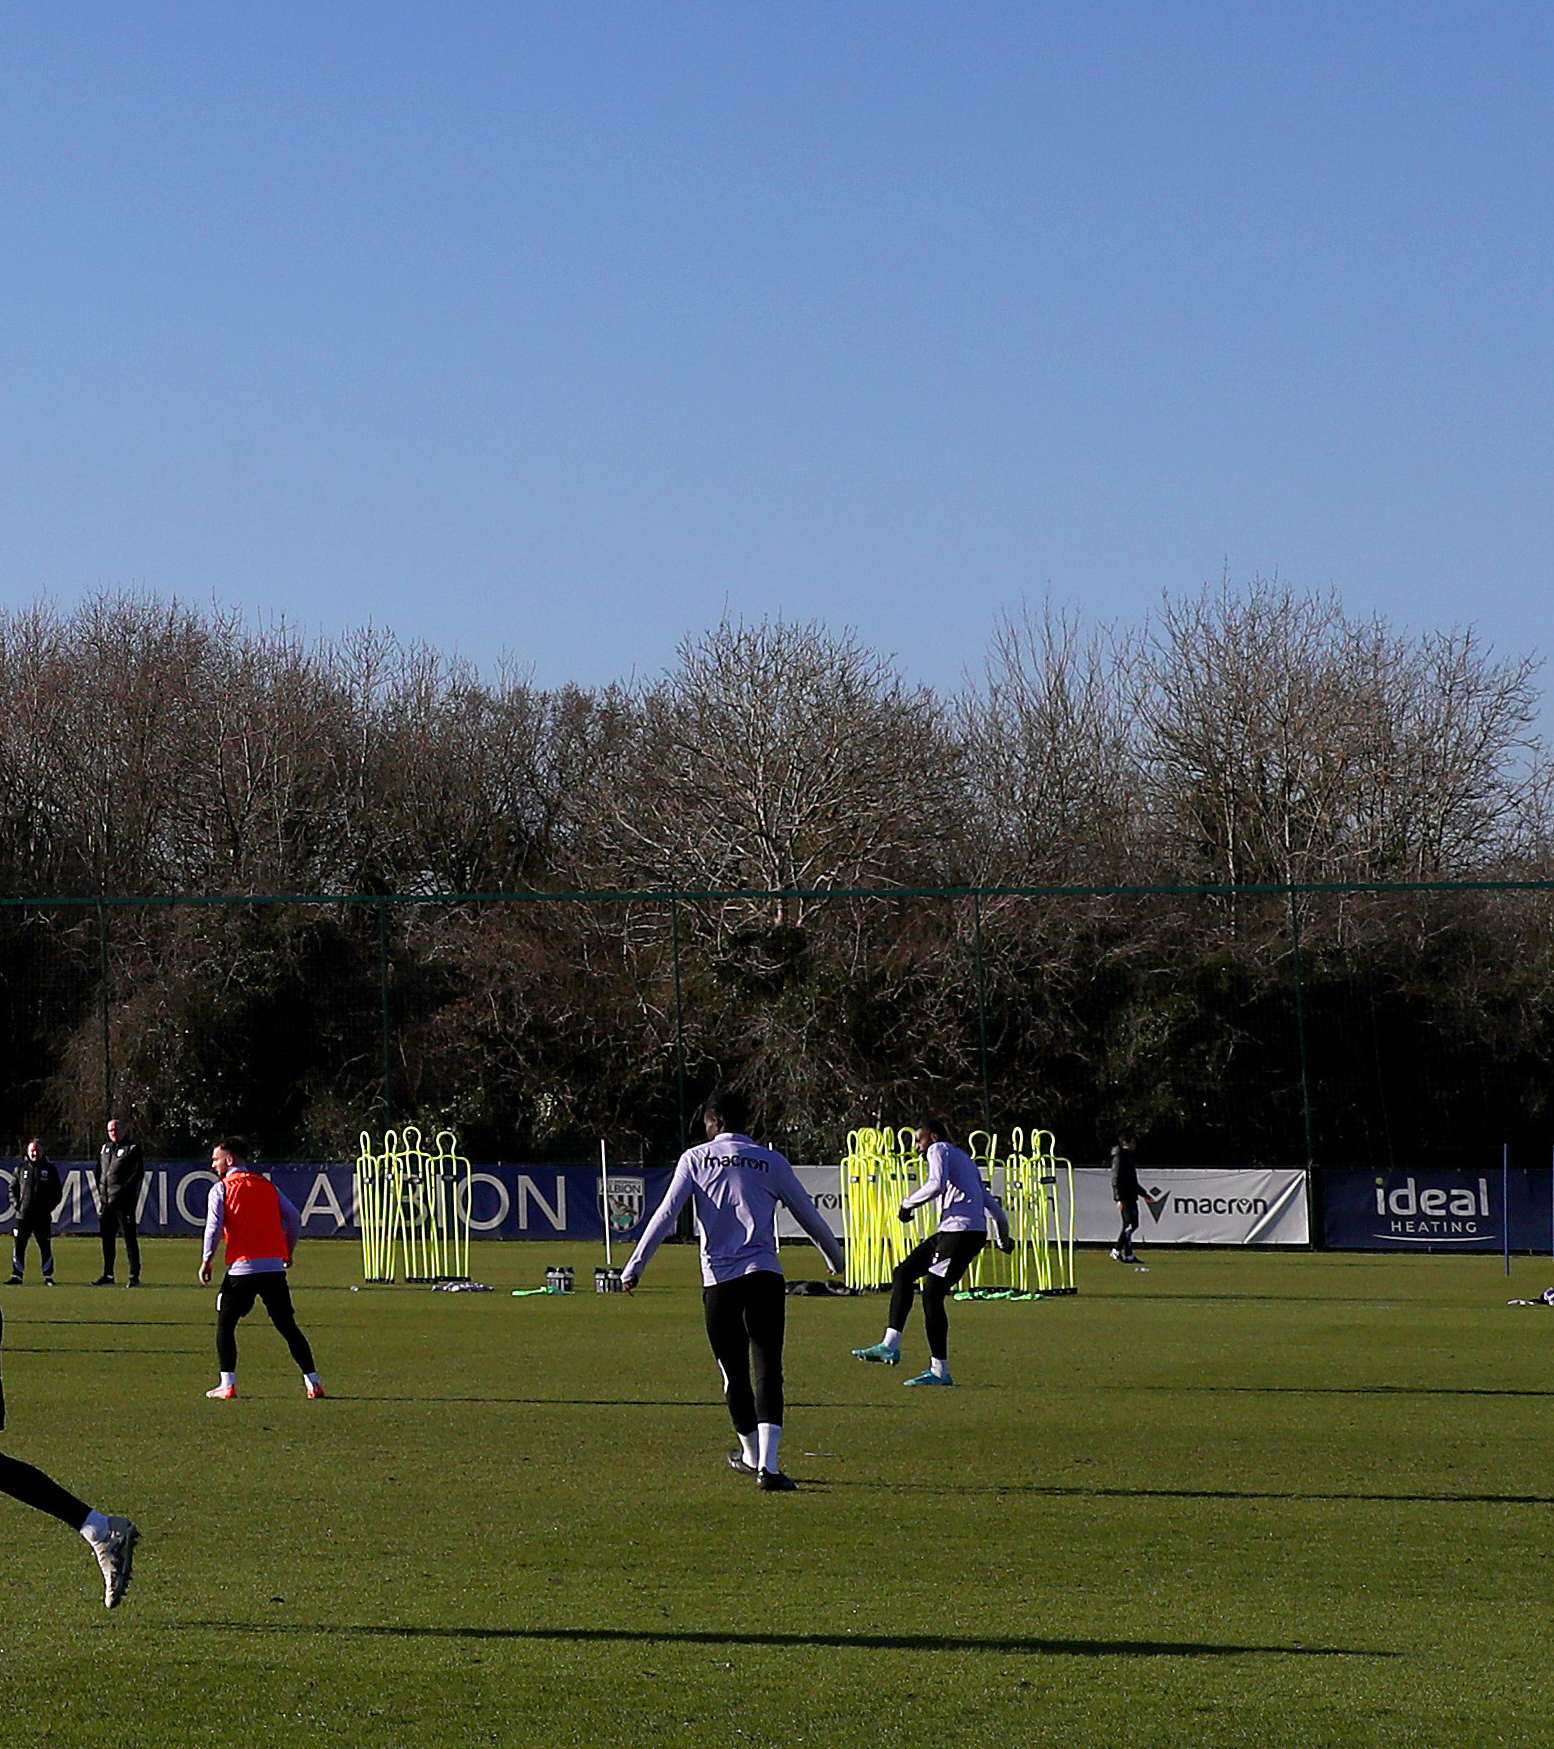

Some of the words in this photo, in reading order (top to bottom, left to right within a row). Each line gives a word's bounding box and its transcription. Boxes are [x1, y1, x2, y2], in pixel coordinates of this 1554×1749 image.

[703, 1154, 770, 1173] macron
[1173, 1197, 1269, 1215] macron
[1374, 1177, 1490, 1217] ideal
[1390, 1220, 1478, 1234] HEATING
